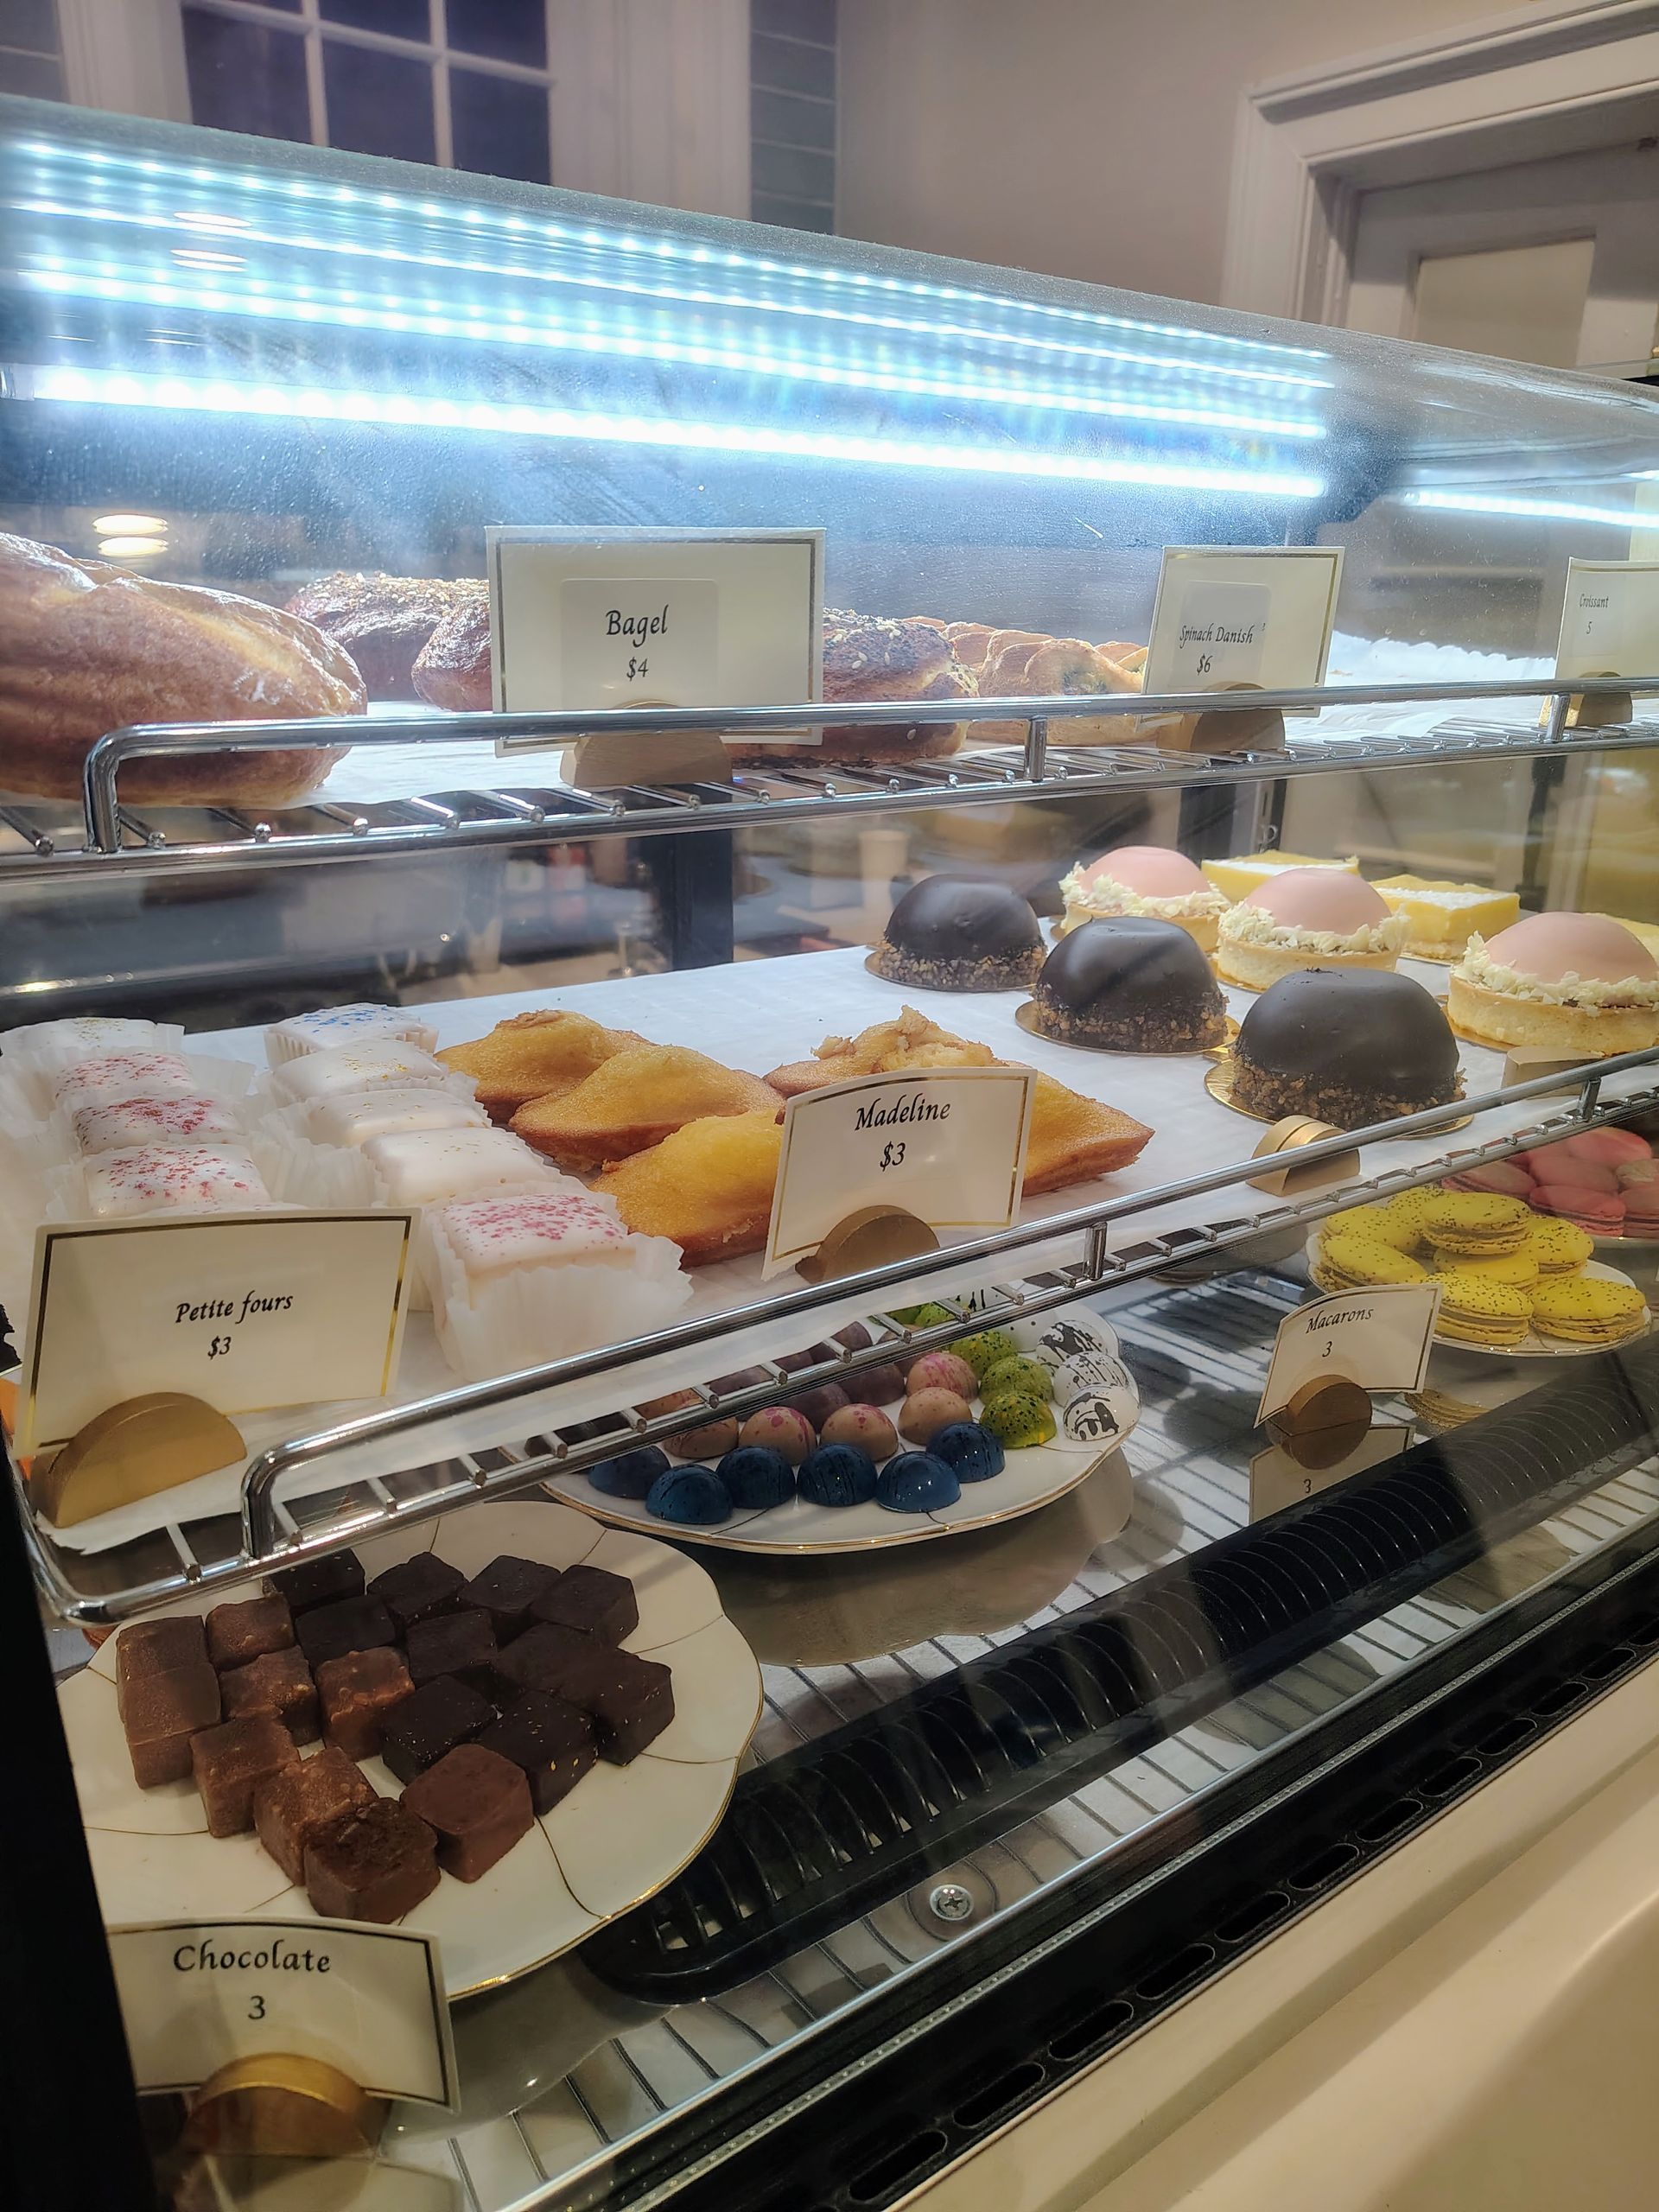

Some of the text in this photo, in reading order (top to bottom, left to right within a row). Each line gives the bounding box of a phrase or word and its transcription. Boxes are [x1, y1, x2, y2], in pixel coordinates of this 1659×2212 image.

[1579, 593, 1610, 609] Croissant
[605, 603, 670, 648] Bagel
[1179, 622, 1215, 650] Spinach
[1215, 624, 1255, 645] Danish
[1586, 620, 1593, 635] 5
[626, 656, 649, 682] $4
[1196, 653, 1214, 676] $6
[854, 1092, 951, 1131] Madeline
[879, 1141, 906, 1173] $3
[175, 1289, 294, 1325] Petite fours
[1305, 1307, 1375, 1335] Macarons
[207, 1335, 232, 1361] $3
[1321, 1340, 1333, 1358] 3
[173, 1938, 331, 1974] Chocolate
[247, 1994, 266, 2020] 3
